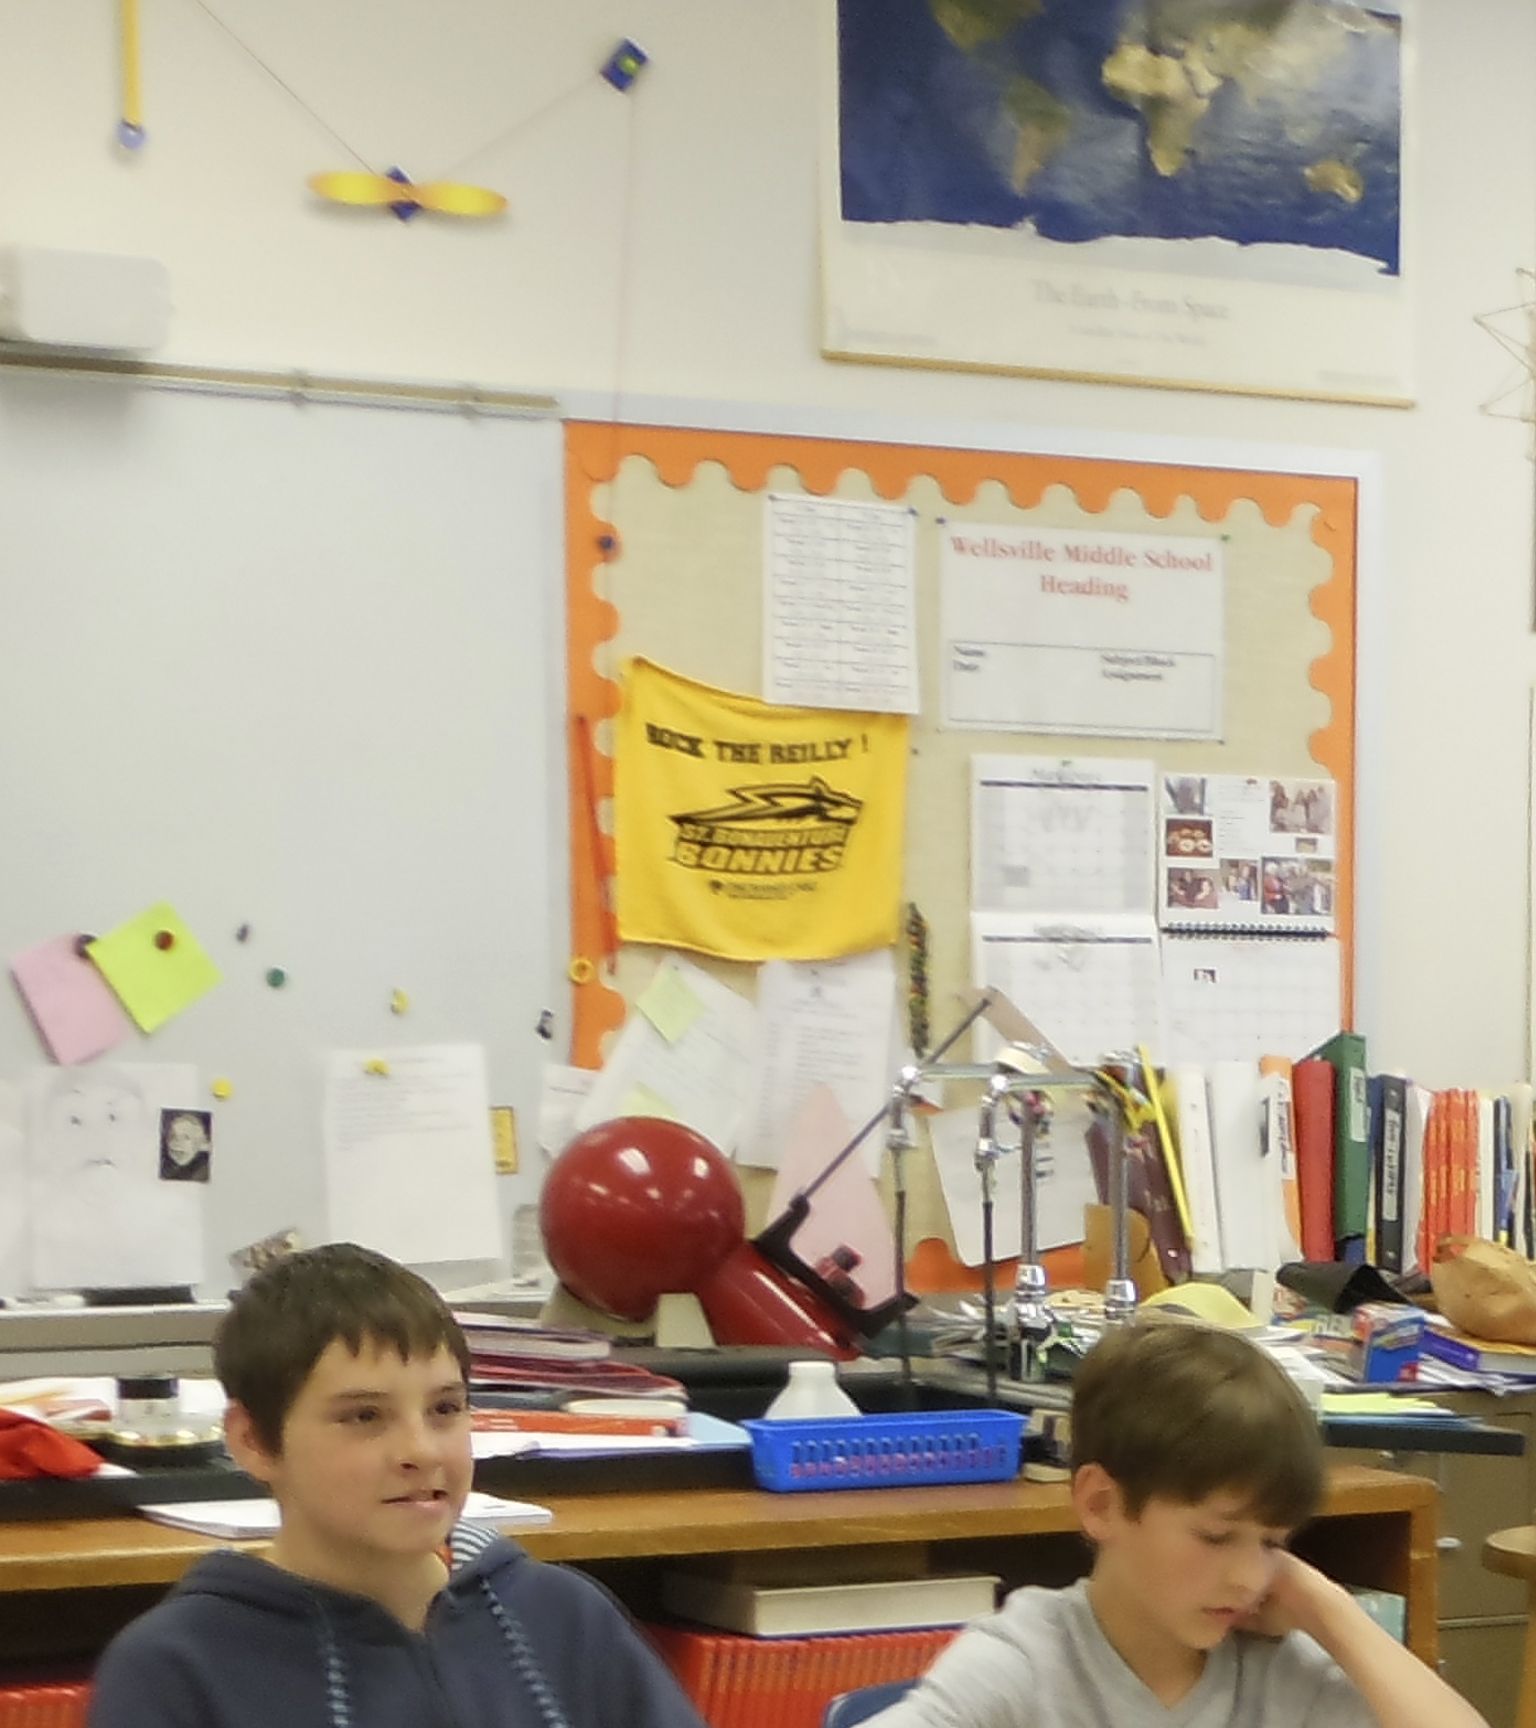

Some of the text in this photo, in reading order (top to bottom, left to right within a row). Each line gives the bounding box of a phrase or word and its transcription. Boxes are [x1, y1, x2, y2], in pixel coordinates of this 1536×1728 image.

[1182, 293, 1230, 322] Space
[950, 536, 1212, 571] Wellsville Middle School
[1040, 574, 1129, 602] Heading
[645, 722, 705, 758] ROCK
[713, 740, 762, 764] THE
[770, 739, 852, 763] REILLY
[676, 842, 846, 876] BONNIES
